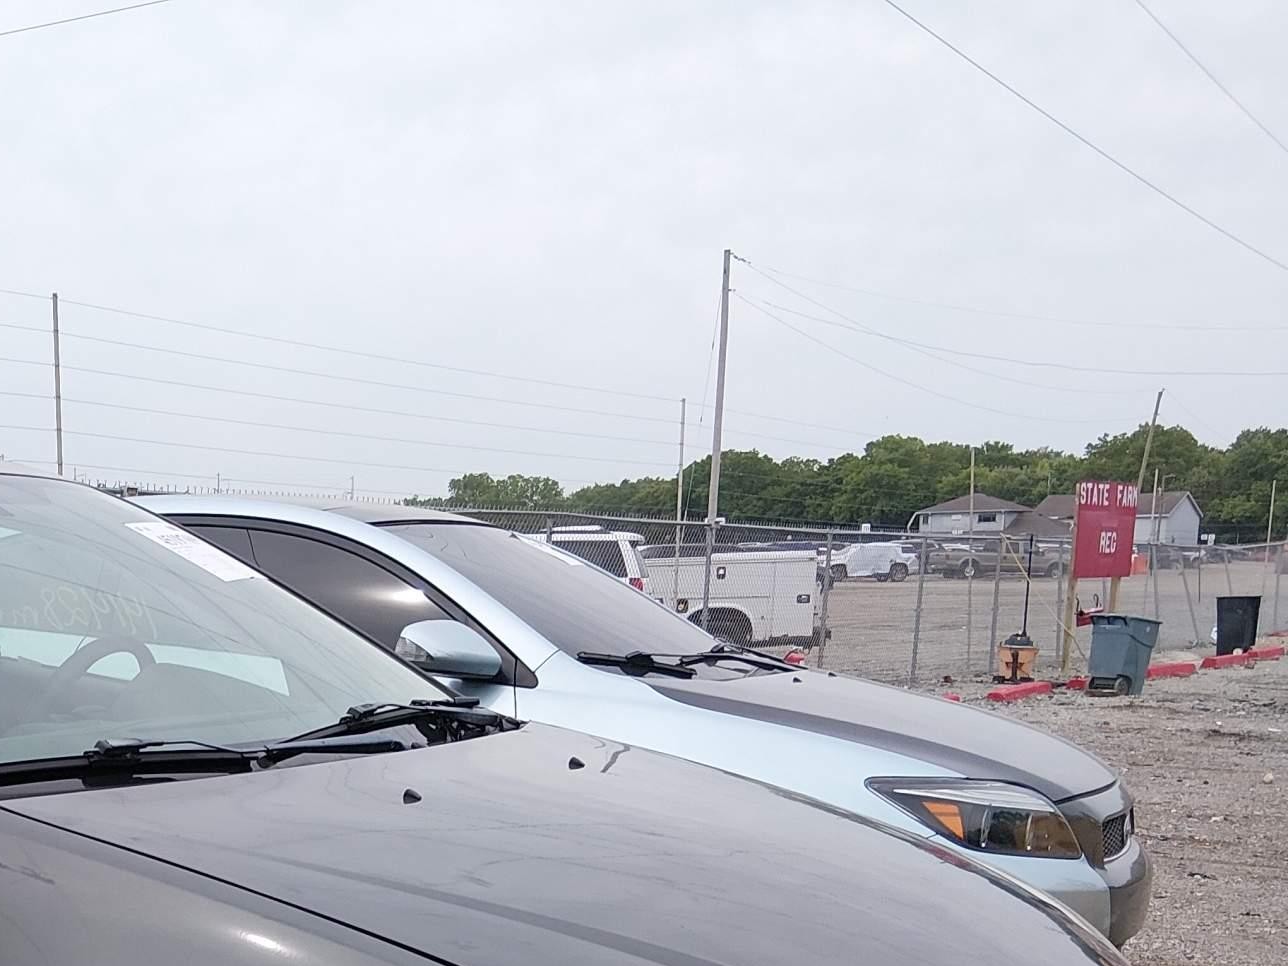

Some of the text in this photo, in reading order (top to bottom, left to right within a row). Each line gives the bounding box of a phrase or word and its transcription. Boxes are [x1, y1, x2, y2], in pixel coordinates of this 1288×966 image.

[1080, 482, 1138, 508] STATE FARM
[1099, 531, 1117, 554] REG
